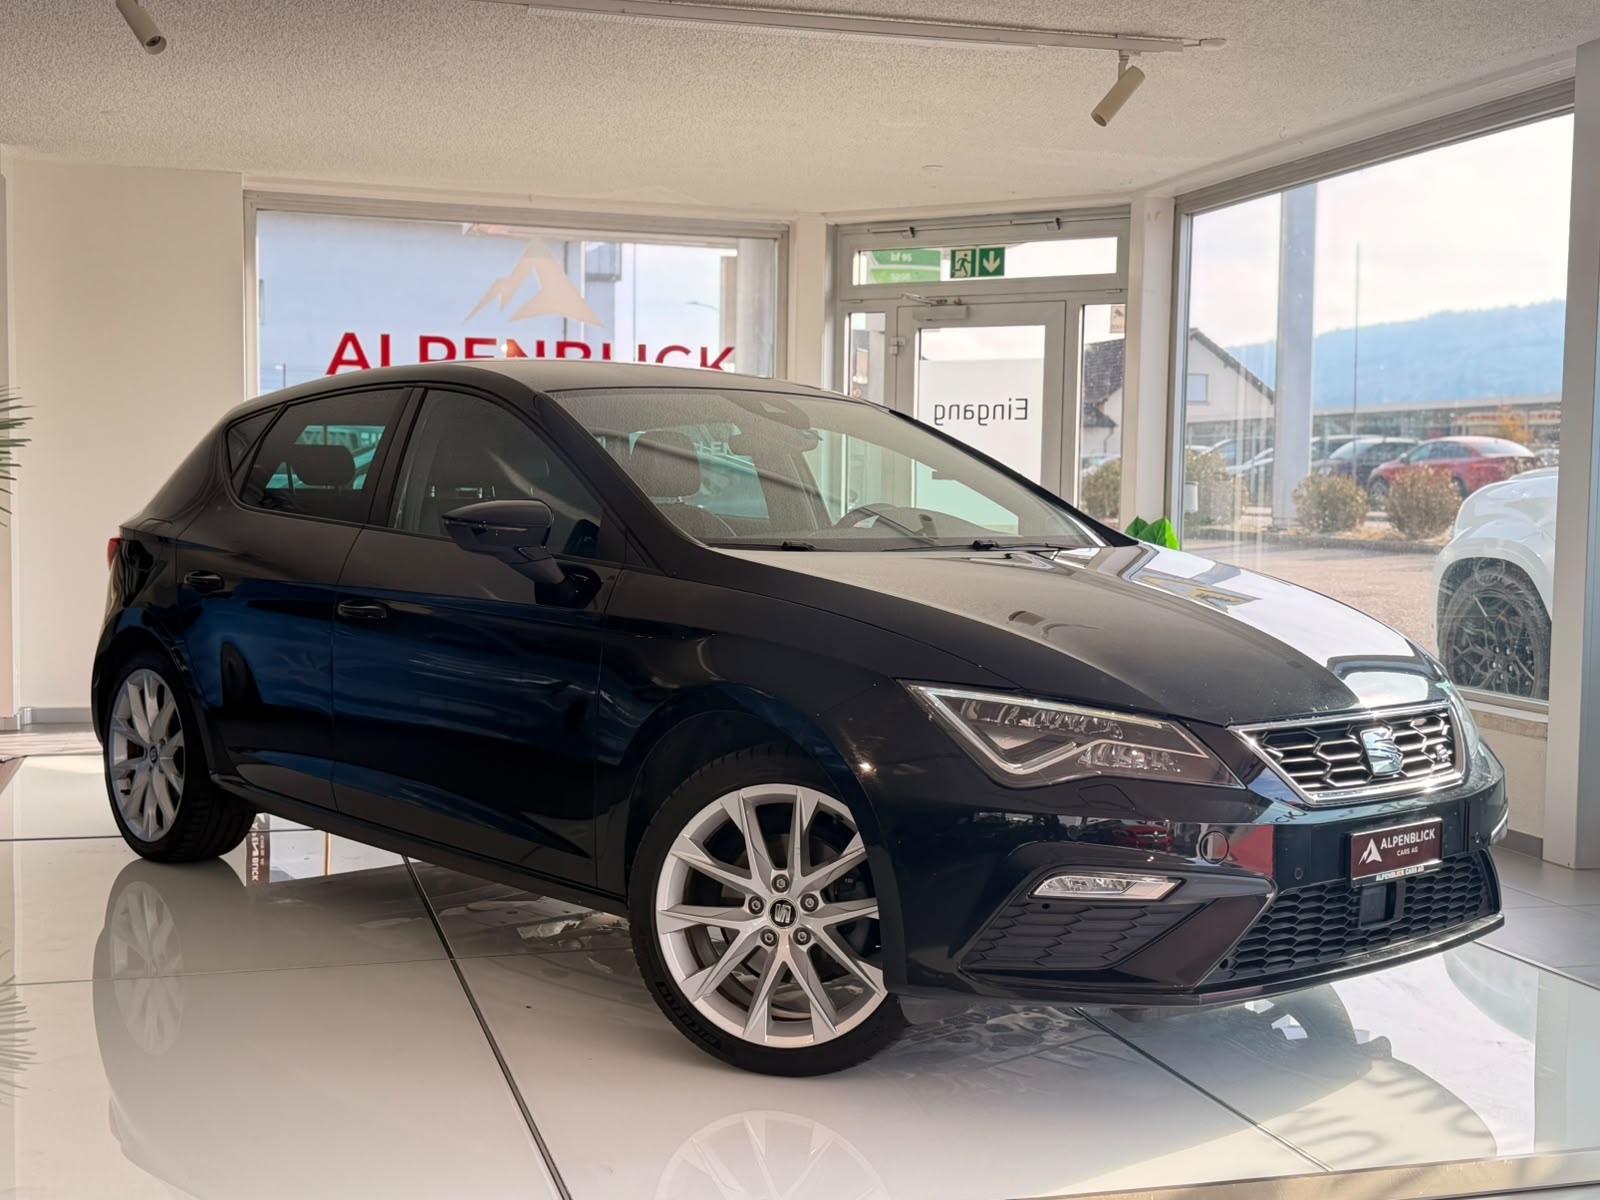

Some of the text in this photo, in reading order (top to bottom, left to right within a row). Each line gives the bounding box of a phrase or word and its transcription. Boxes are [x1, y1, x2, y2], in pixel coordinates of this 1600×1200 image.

[1380, 828, 1436, 850] ALPENBLICK
[1396, 848, 1410, 857] CARS
[1375, 869, 1405, 881] ALPENBLICK
